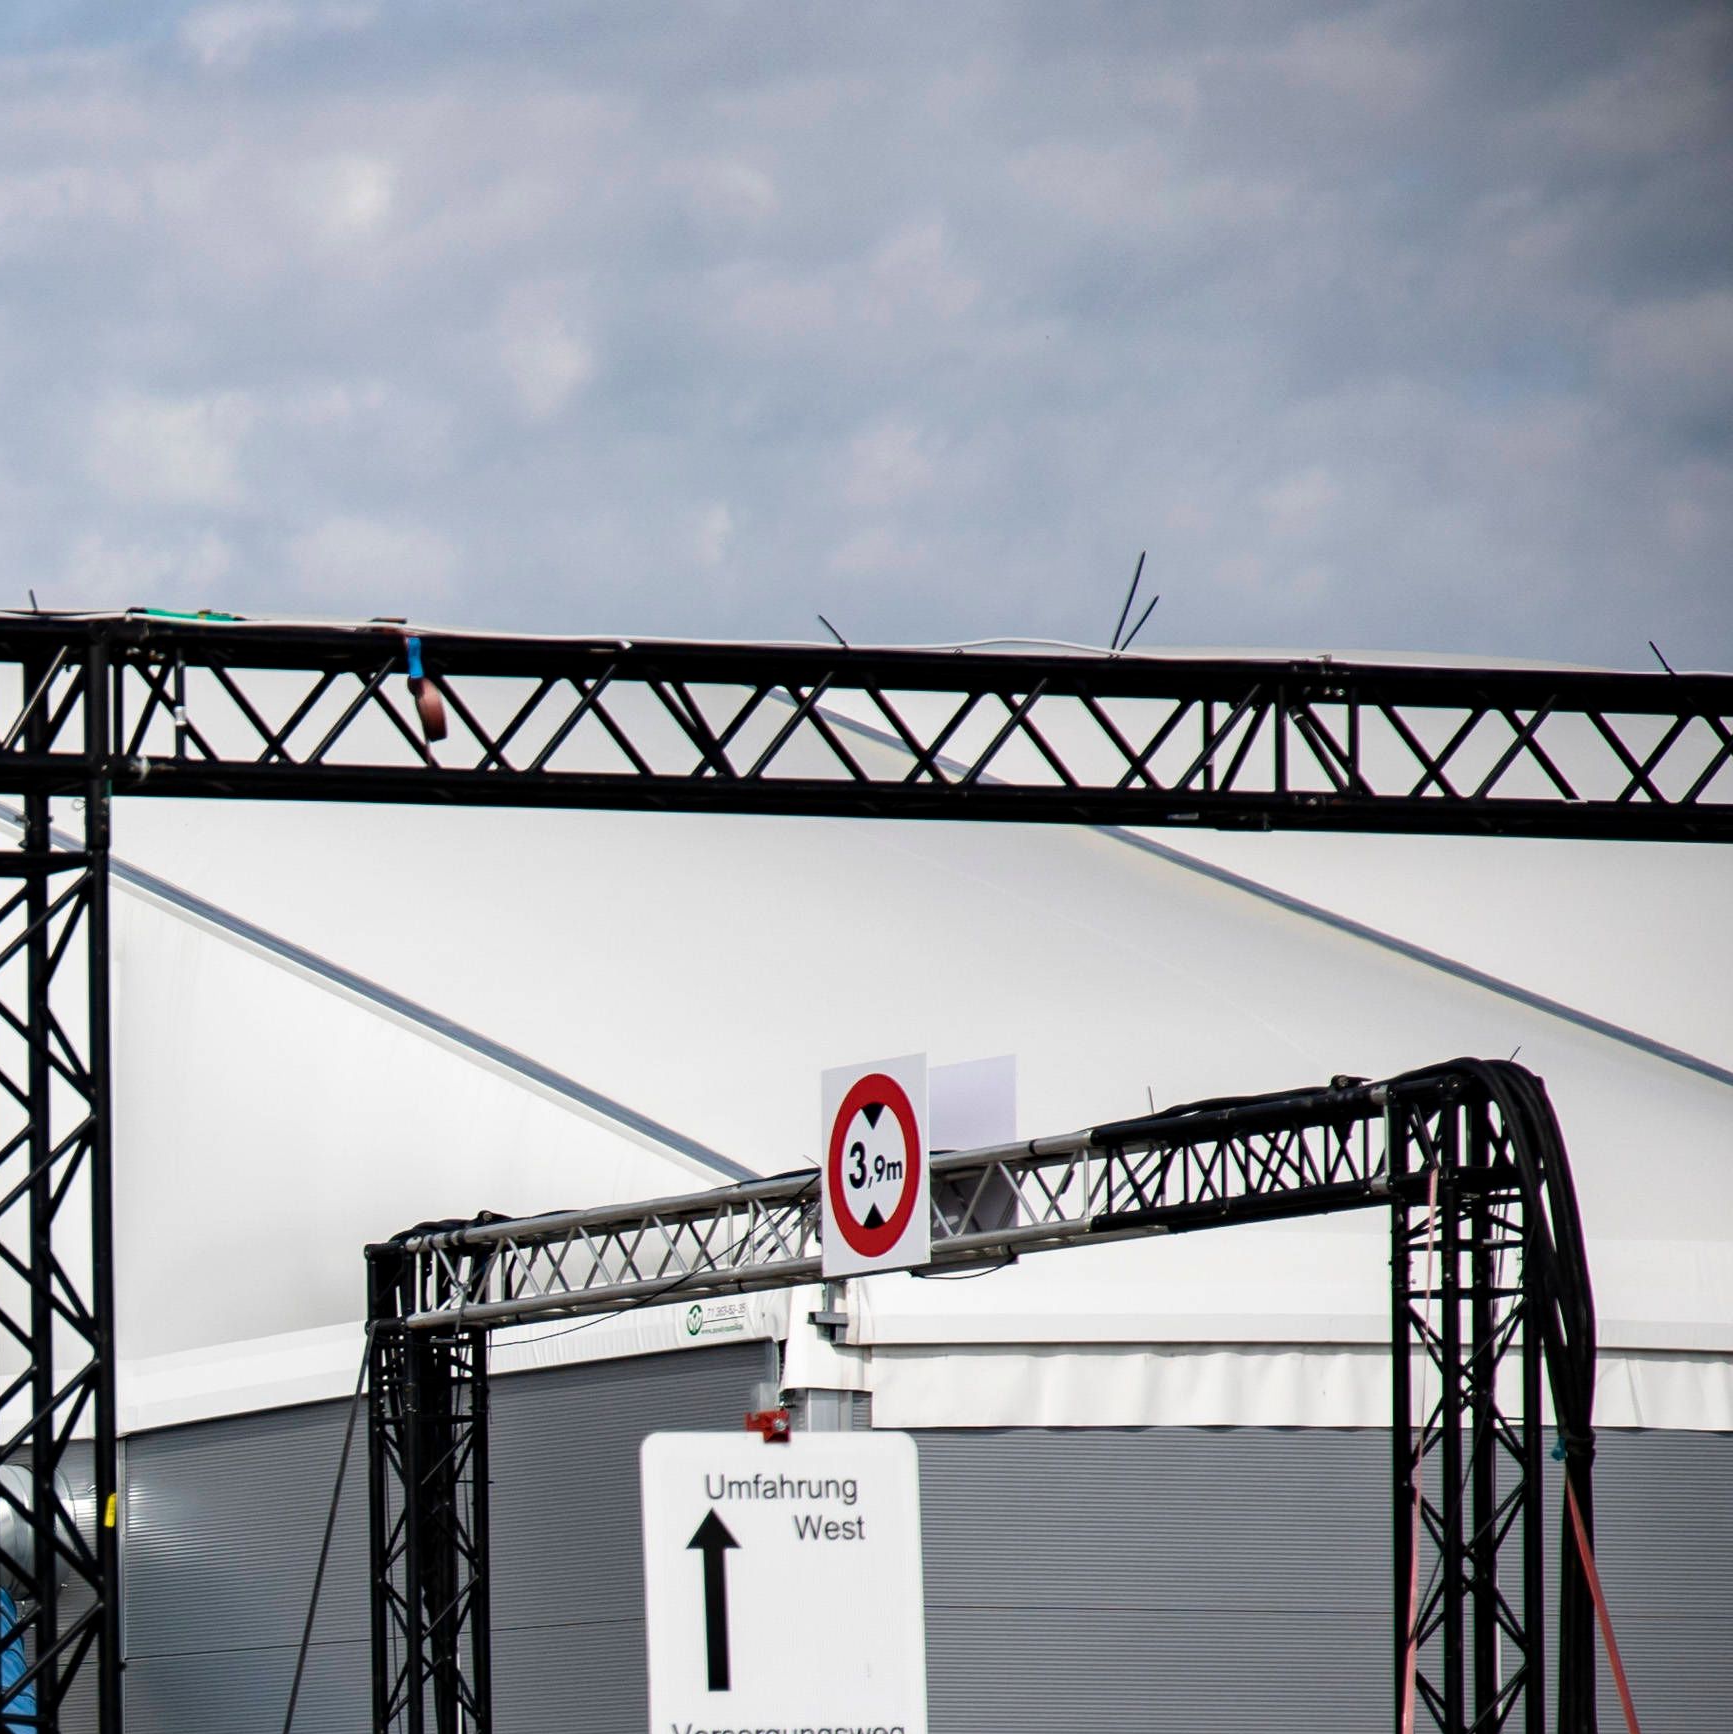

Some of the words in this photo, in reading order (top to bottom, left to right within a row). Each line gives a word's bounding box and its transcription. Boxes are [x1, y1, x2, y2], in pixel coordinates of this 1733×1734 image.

[849, 1141, 903, 1190] 3,9m
[705, 1473, 858, 1506] Umfahrung
[793, 1514, 866, 1541] West
